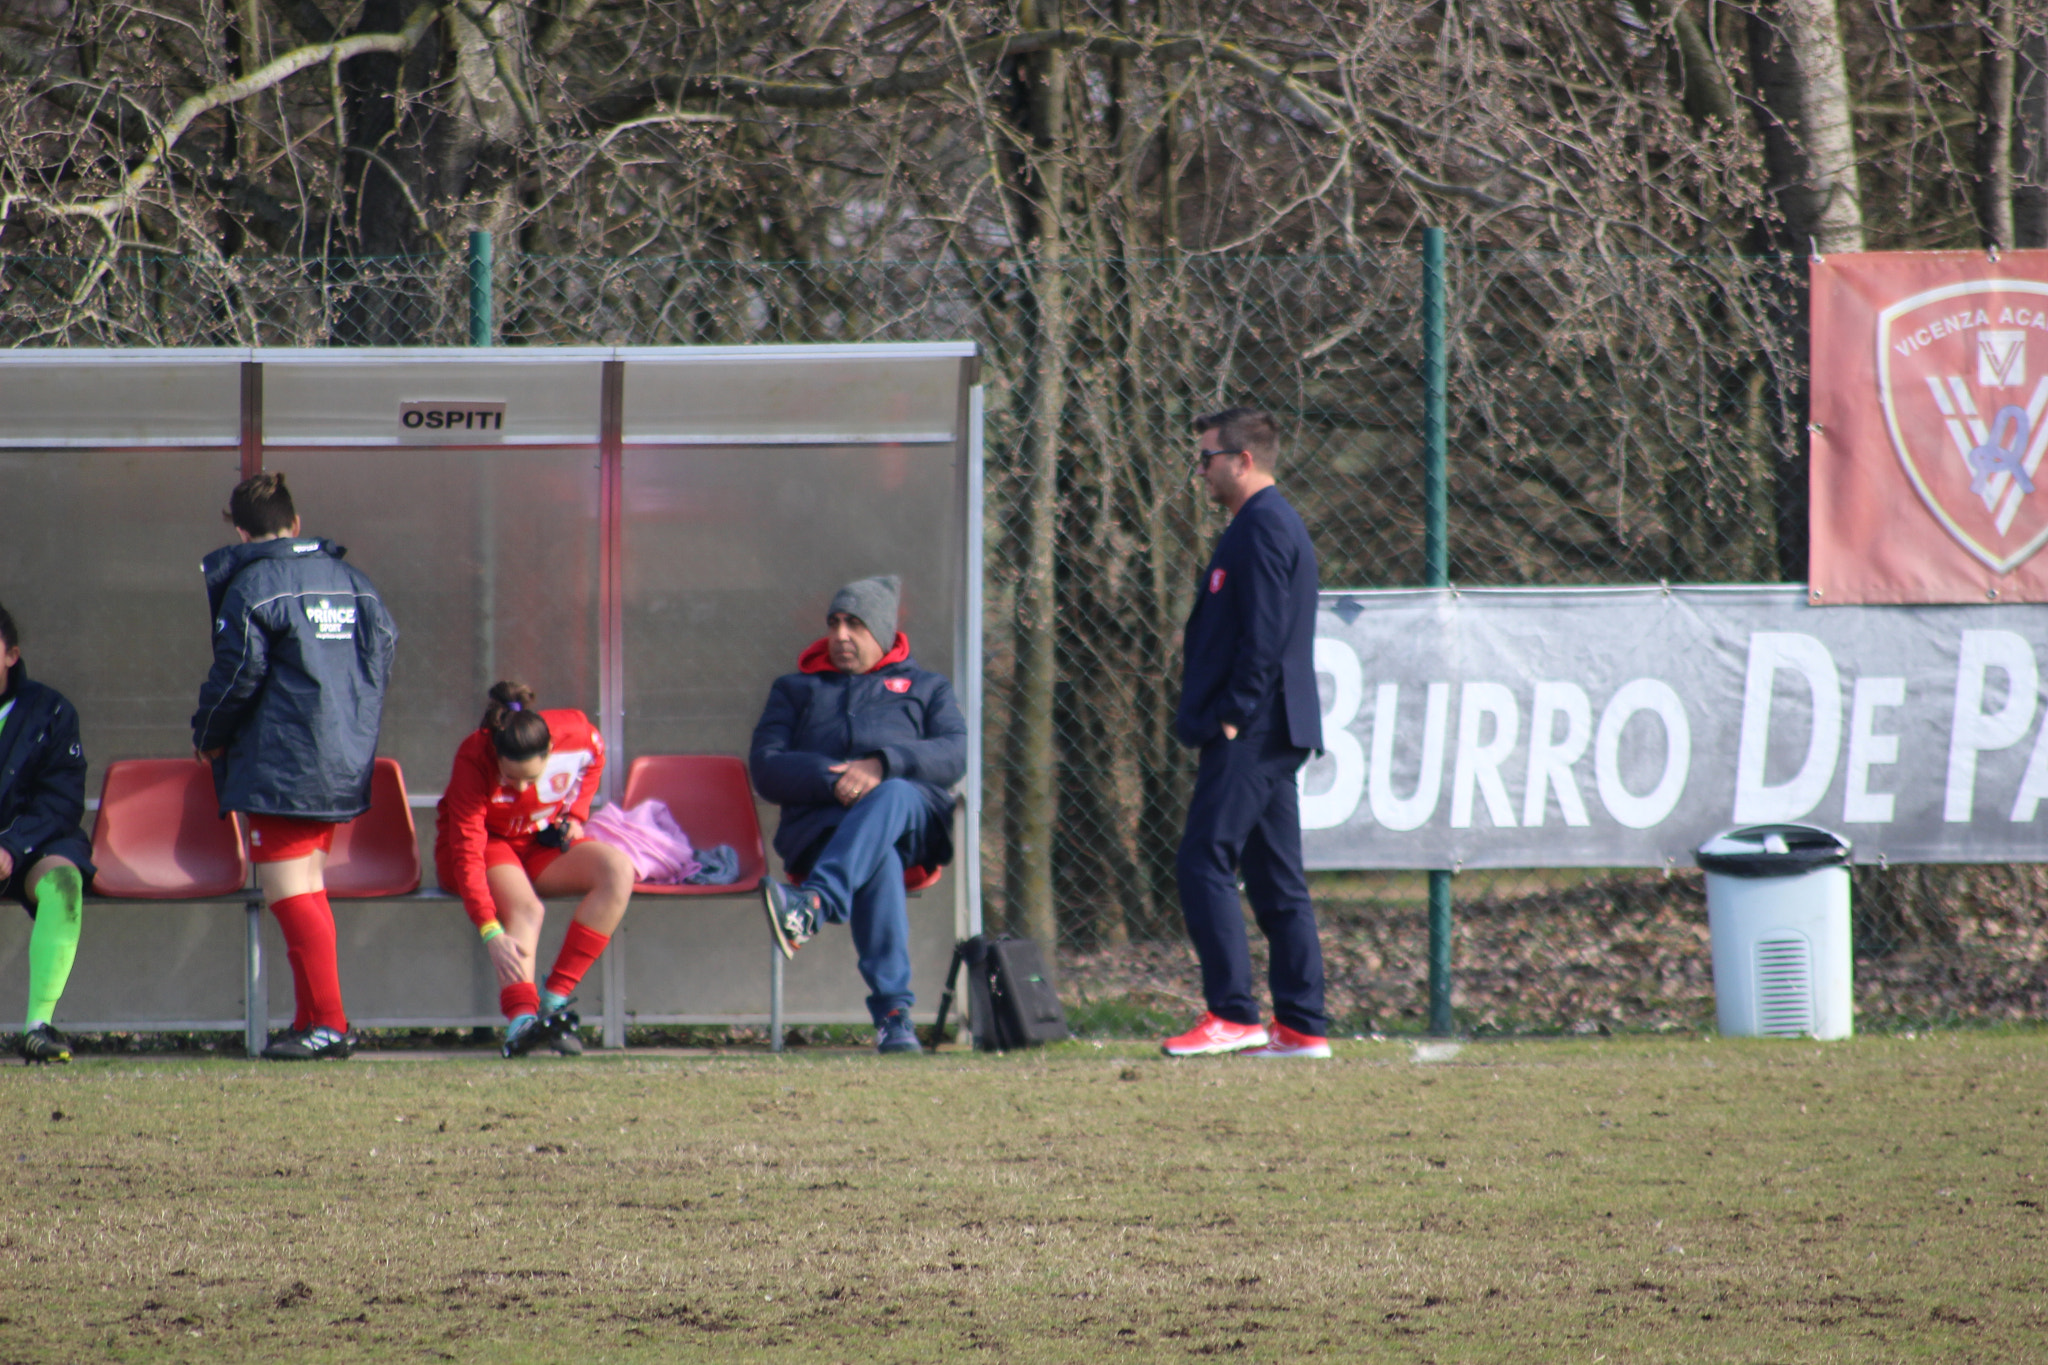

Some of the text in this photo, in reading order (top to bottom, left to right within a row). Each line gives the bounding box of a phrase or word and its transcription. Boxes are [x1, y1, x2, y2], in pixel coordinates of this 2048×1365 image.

[1894, 307, 2048, 357] VICENZA ACA
[402, 410, 502, 429] OSPITI
[305, 607, 356, 623] PRINCE
[1295, 637, 1692, 831] BURRO
